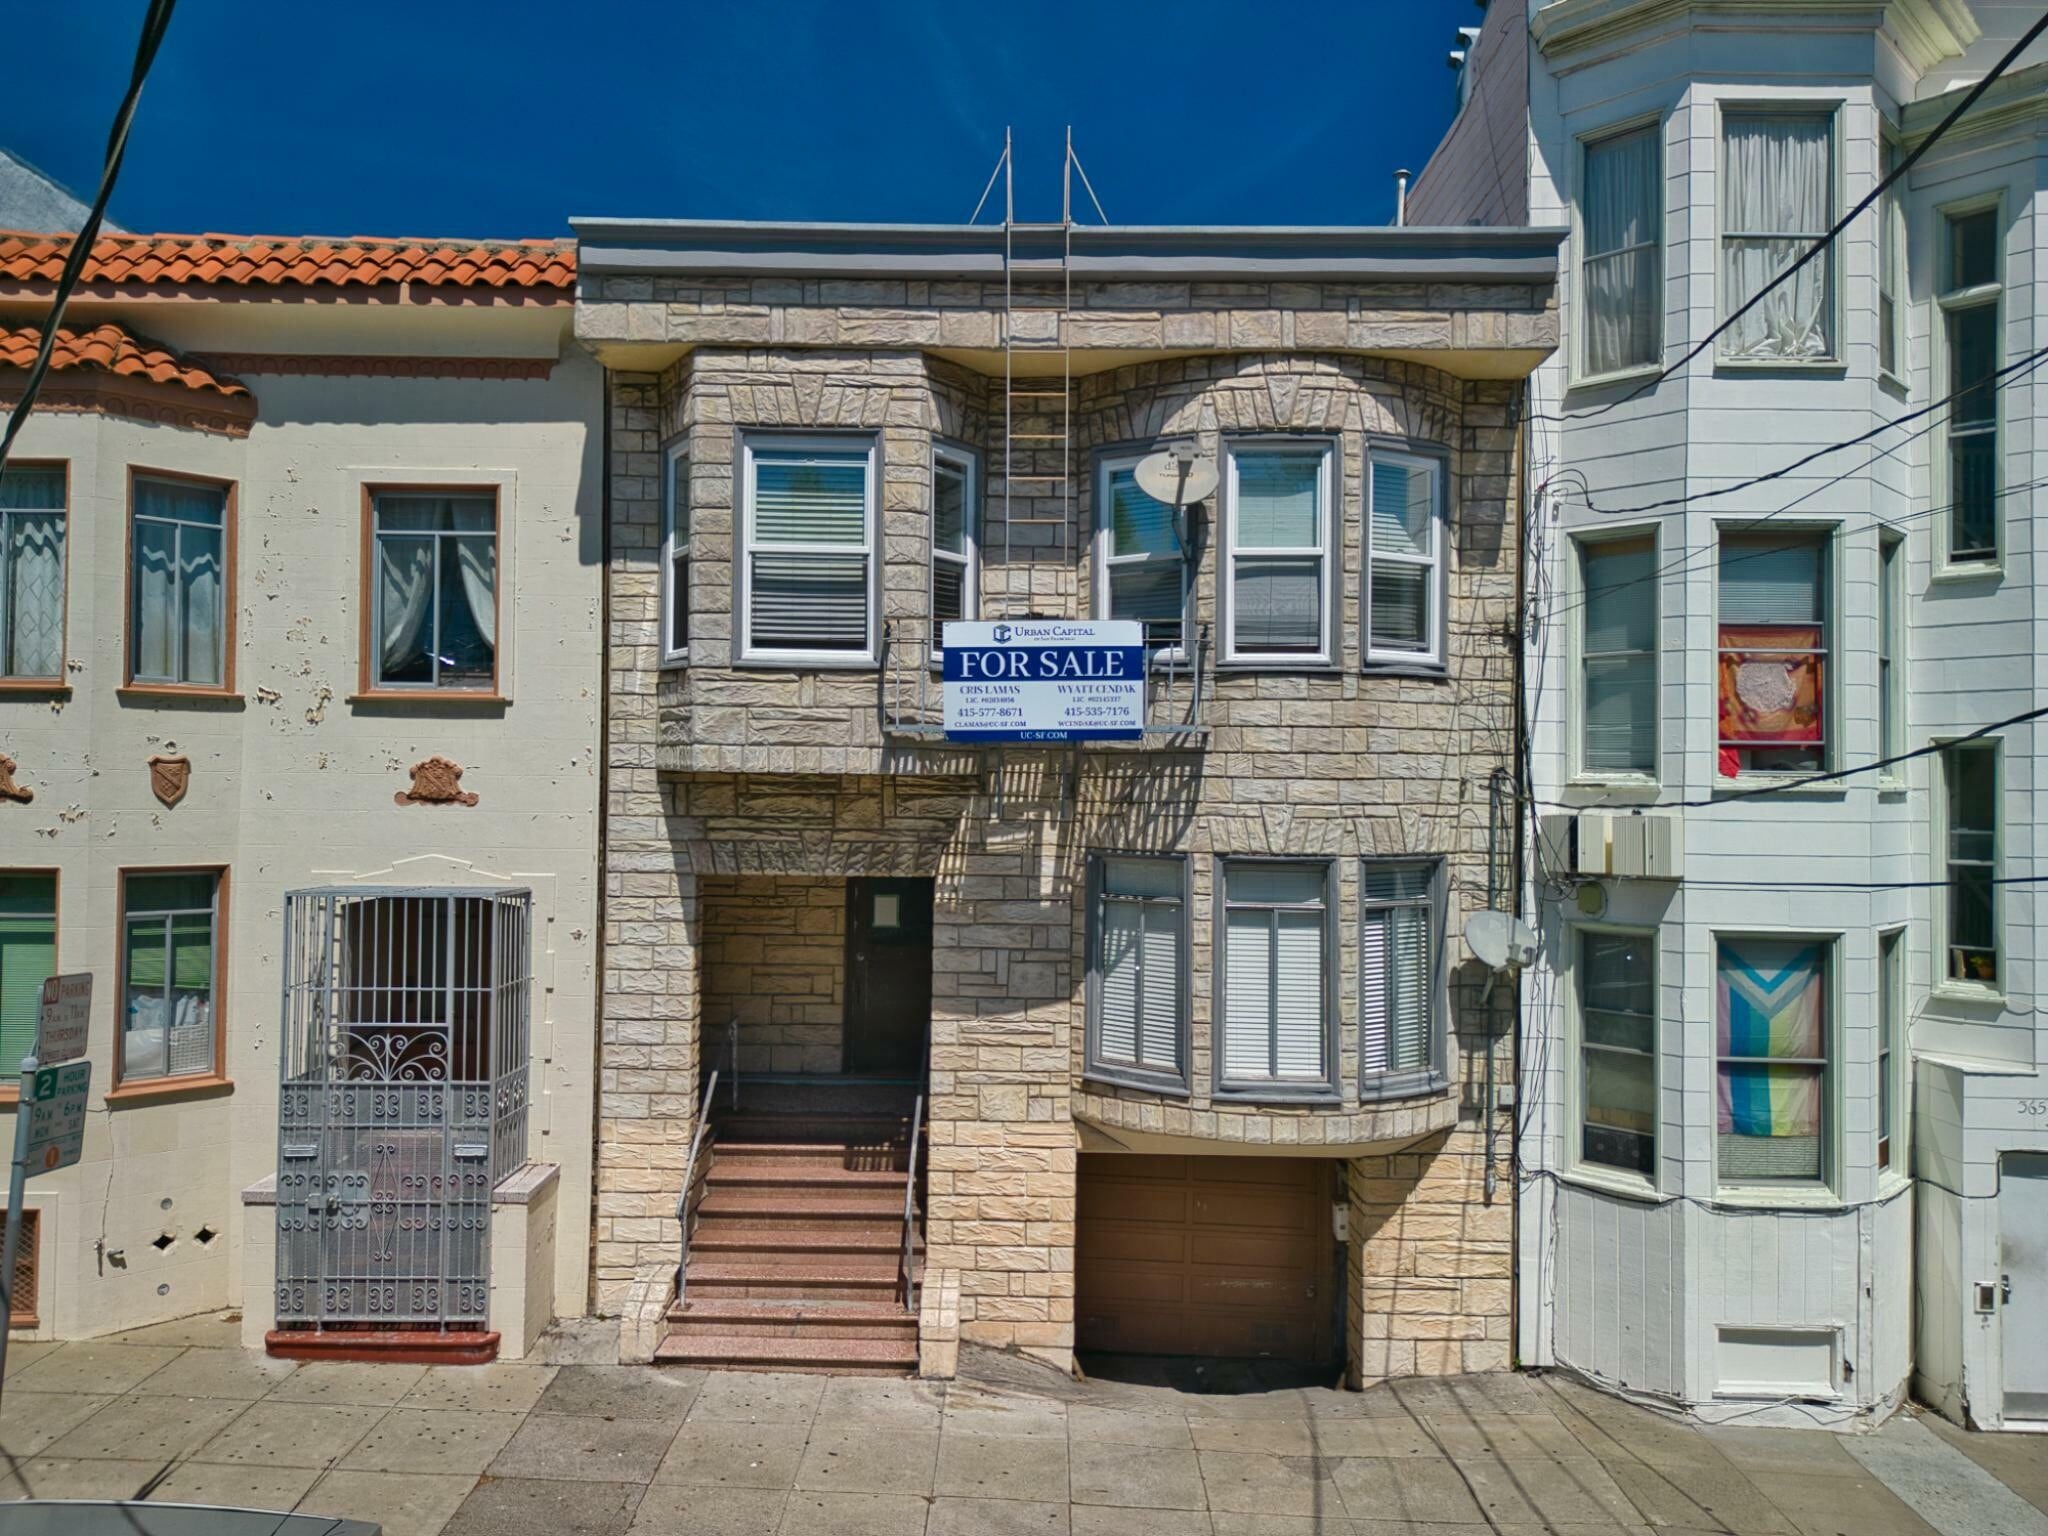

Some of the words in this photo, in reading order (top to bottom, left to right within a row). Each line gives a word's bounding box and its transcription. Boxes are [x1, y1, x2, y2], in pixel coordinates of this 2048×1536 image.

[959, 651, 1031, 678] FOR
[1040, 650, 1124, 677] SALE
[959, 685, 983, 694] CRIS
[985, 685, 1020, 694] LAMAS
[1057, 684, 1093, 694] WYATT
[1095, 684, 1136, 693] CENDAK
[958, 707, 1022, 717] 415-577-8671
[1064, 707, 1129, 716] 415-535-7176
[45, 979, 58, 1003] NO
[61, 981, 89, 997] PARKING
[45, 1026, 83, 1045] THURSDAY
[63, 1069, 87, 1082] HOUR
[39, 1074, 52, 1097] 2
[56, 1081, 87, 1096] PARKING
